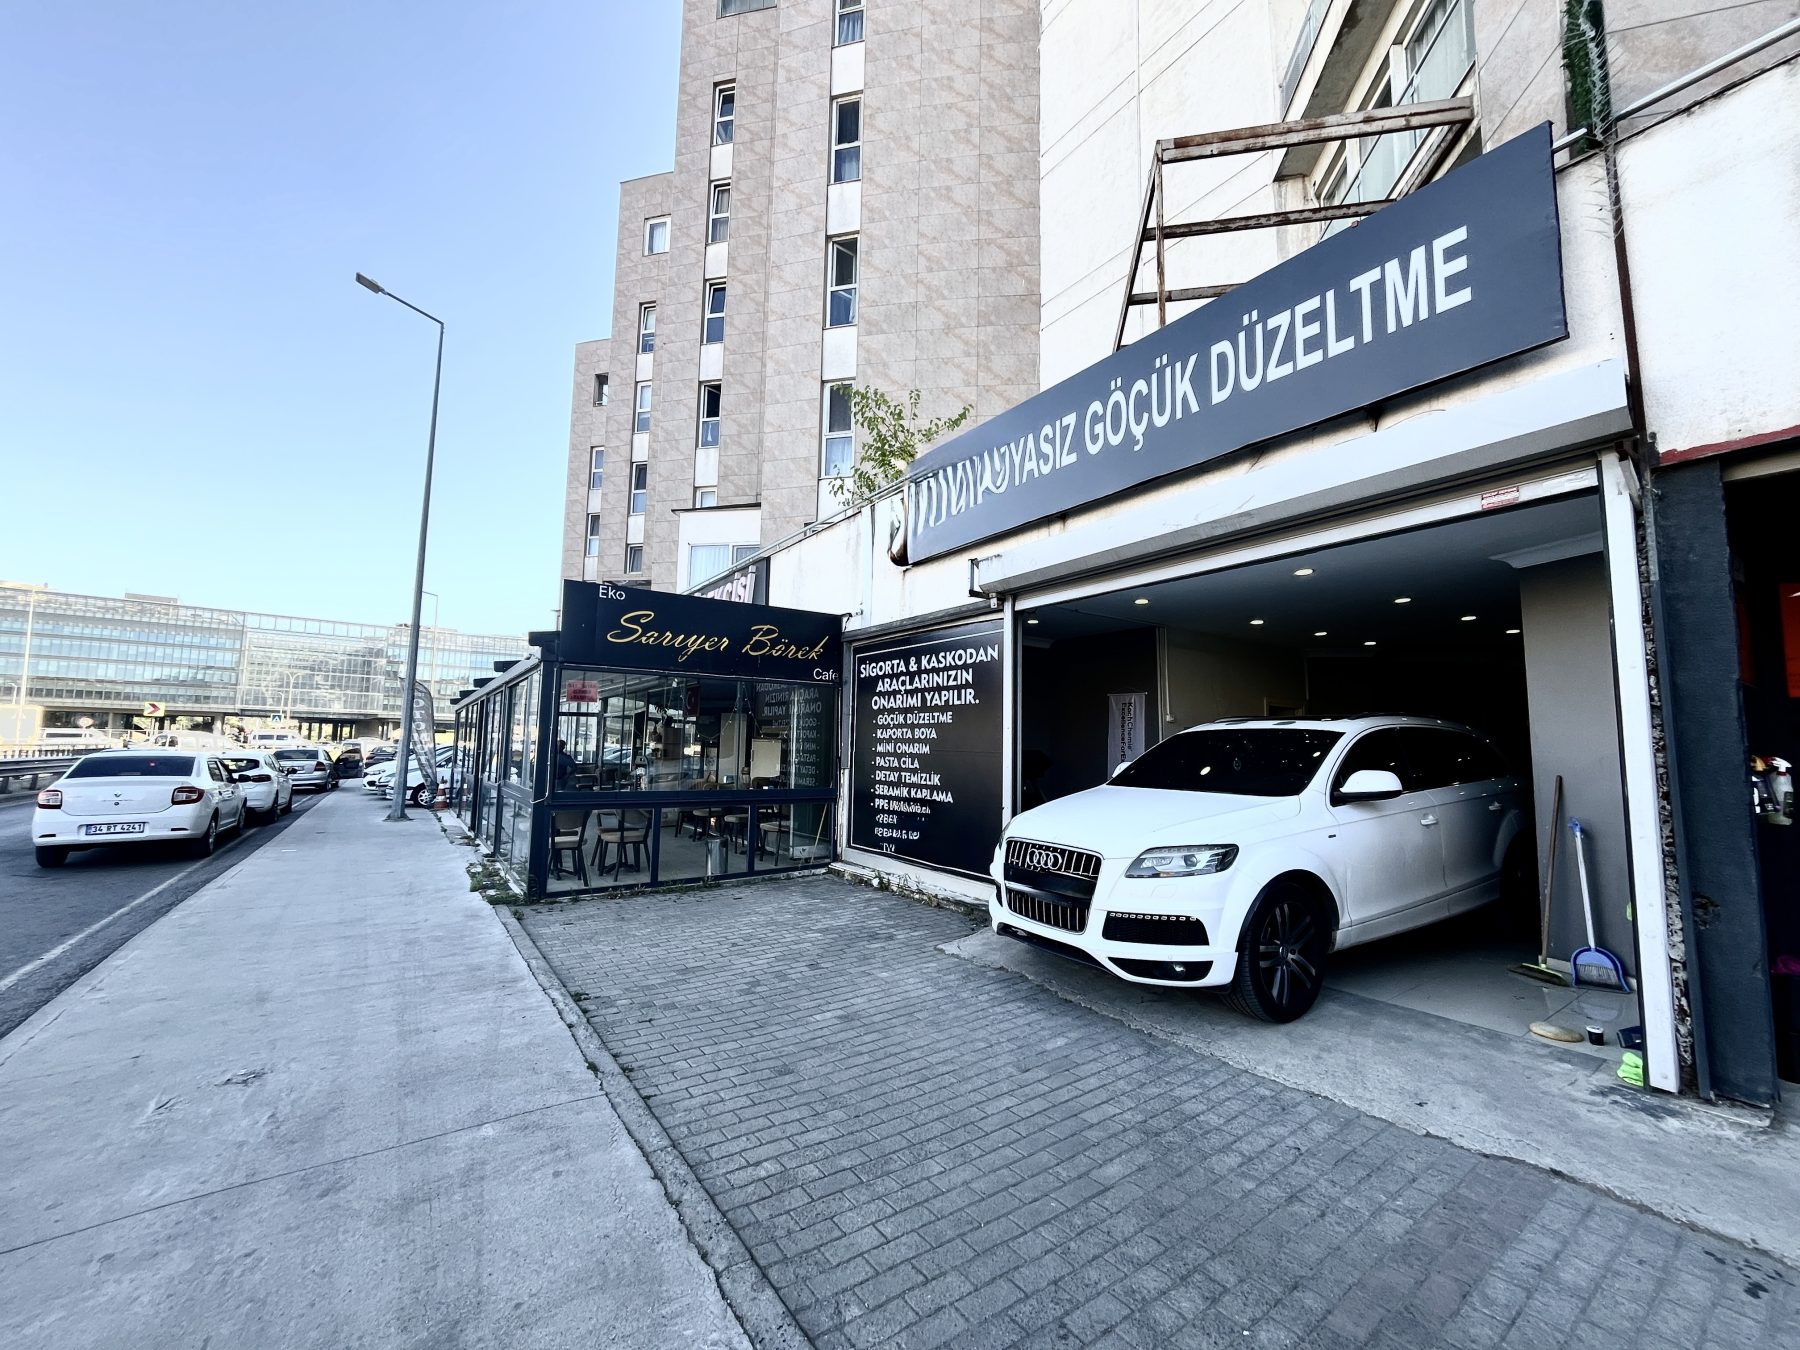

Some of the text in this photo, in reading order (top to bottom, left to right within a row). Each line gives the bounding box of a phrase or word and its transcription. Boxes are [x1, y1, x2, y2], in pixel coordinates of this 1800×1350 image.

[1084, 353, 1201, 452] GÖÇÜK
[1210, 225, 1472, 406] DÜZELTME
[599, 585, 626, 601] Eko
[742, 624, 829, 661] Börek
[860, 644, 999, 678] SİGORTA & KASKODAN
[813, 668, 839, 681] Cafe
[876, 668, 973, 694] ARAÇLARINIZIN
[871, 688, 980, 710] ONARIMI YAPILIR.
[877, 711, 953, 727] GÖÇÜK DÜZELTME
[877, 728, 937, 739] KAPORTA BOYA
[876, 740, 930, 754] MİNİ ONARIM
[875, 755, 919, 769] PASTA CİLA
[875, 770, 941, 786] DETAY TEMİZLİK
[875, 784, 954, 803] SERAMİK KAPLAMA
